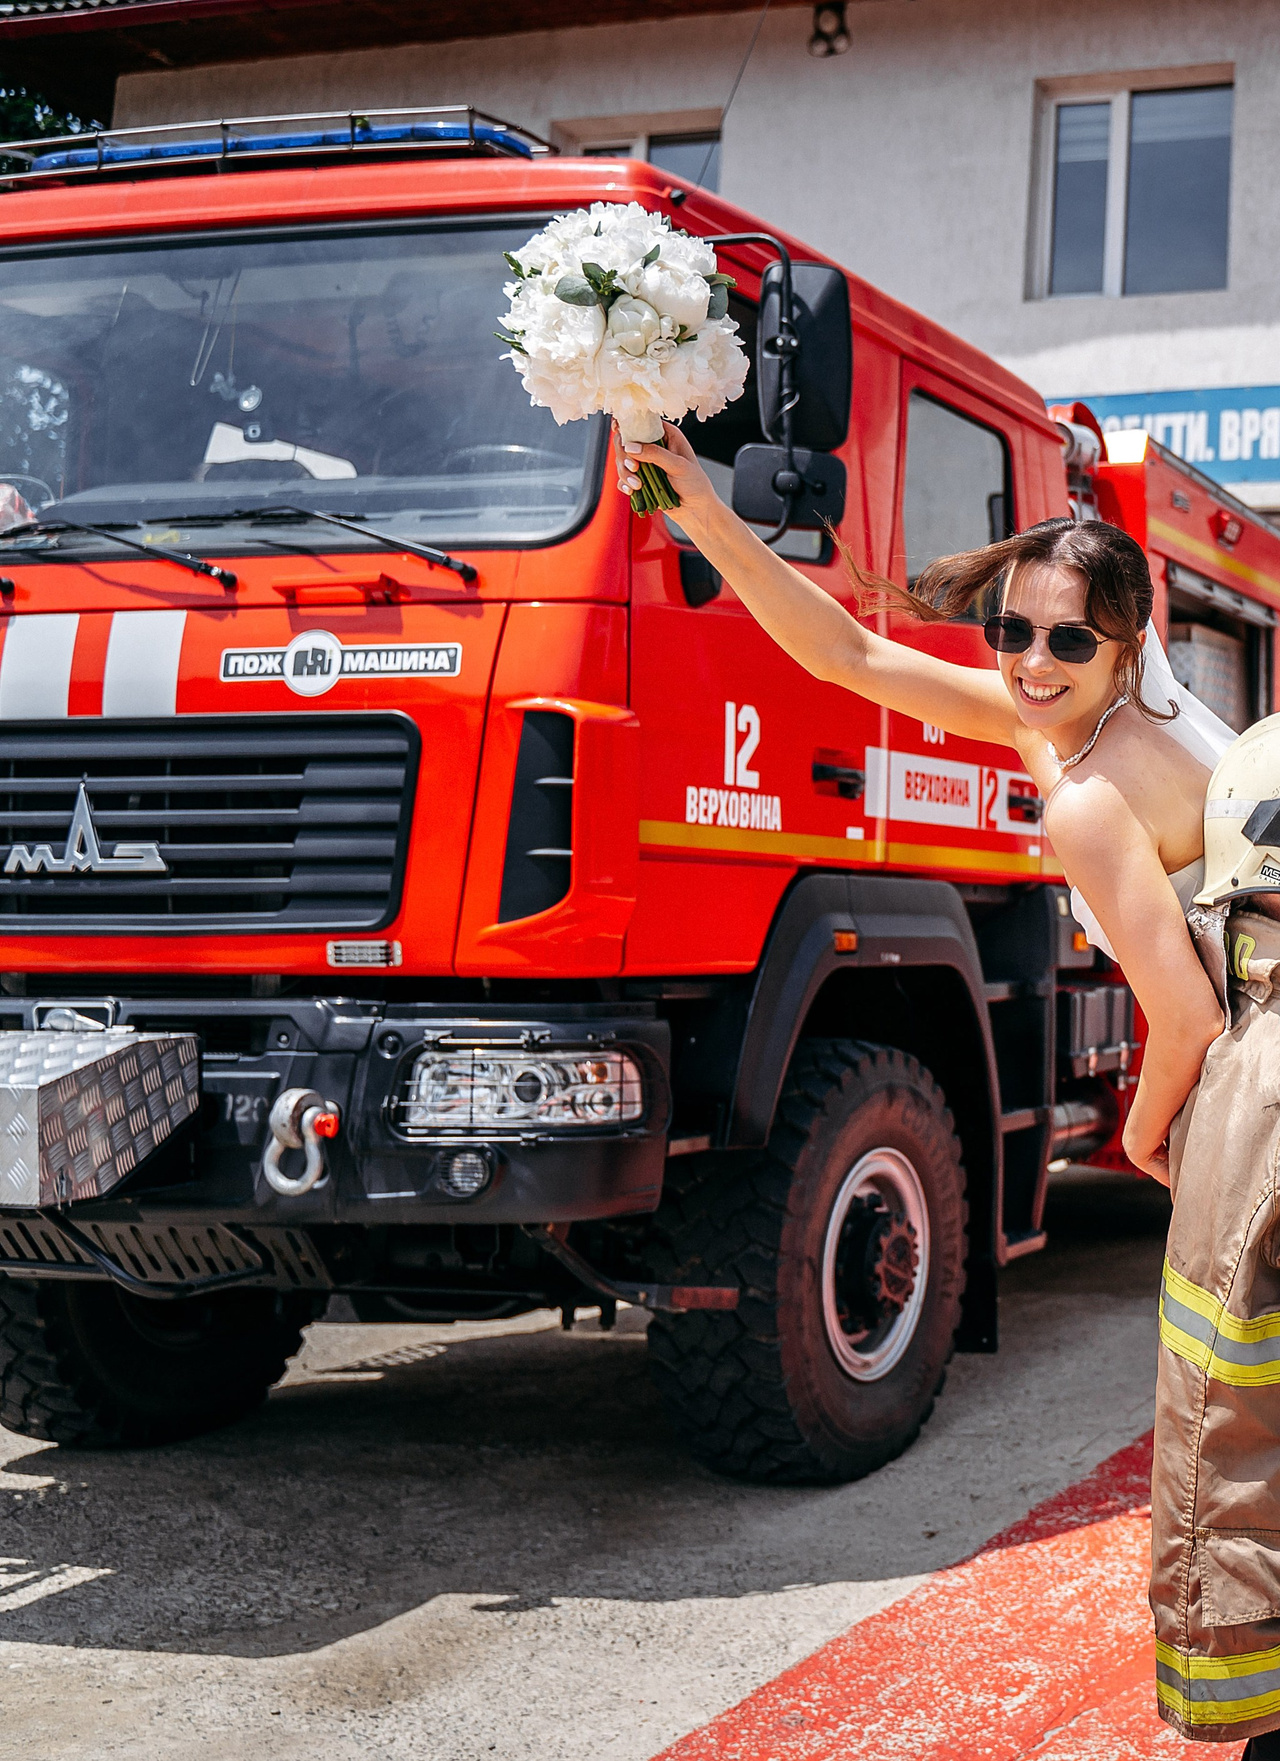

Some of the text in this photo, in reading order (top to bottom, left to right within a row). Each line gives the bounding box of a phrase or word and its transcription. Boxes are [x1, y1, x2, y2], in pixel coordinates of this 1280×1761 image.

[228, 650, 452, 675] ПОЖ МАШИНА
[724, 701, 761, 789] 12
[685, 785, 782, 832] ВЕРХОВИНА
[904, 769, 971, 808] ВЕРХОВИНА
